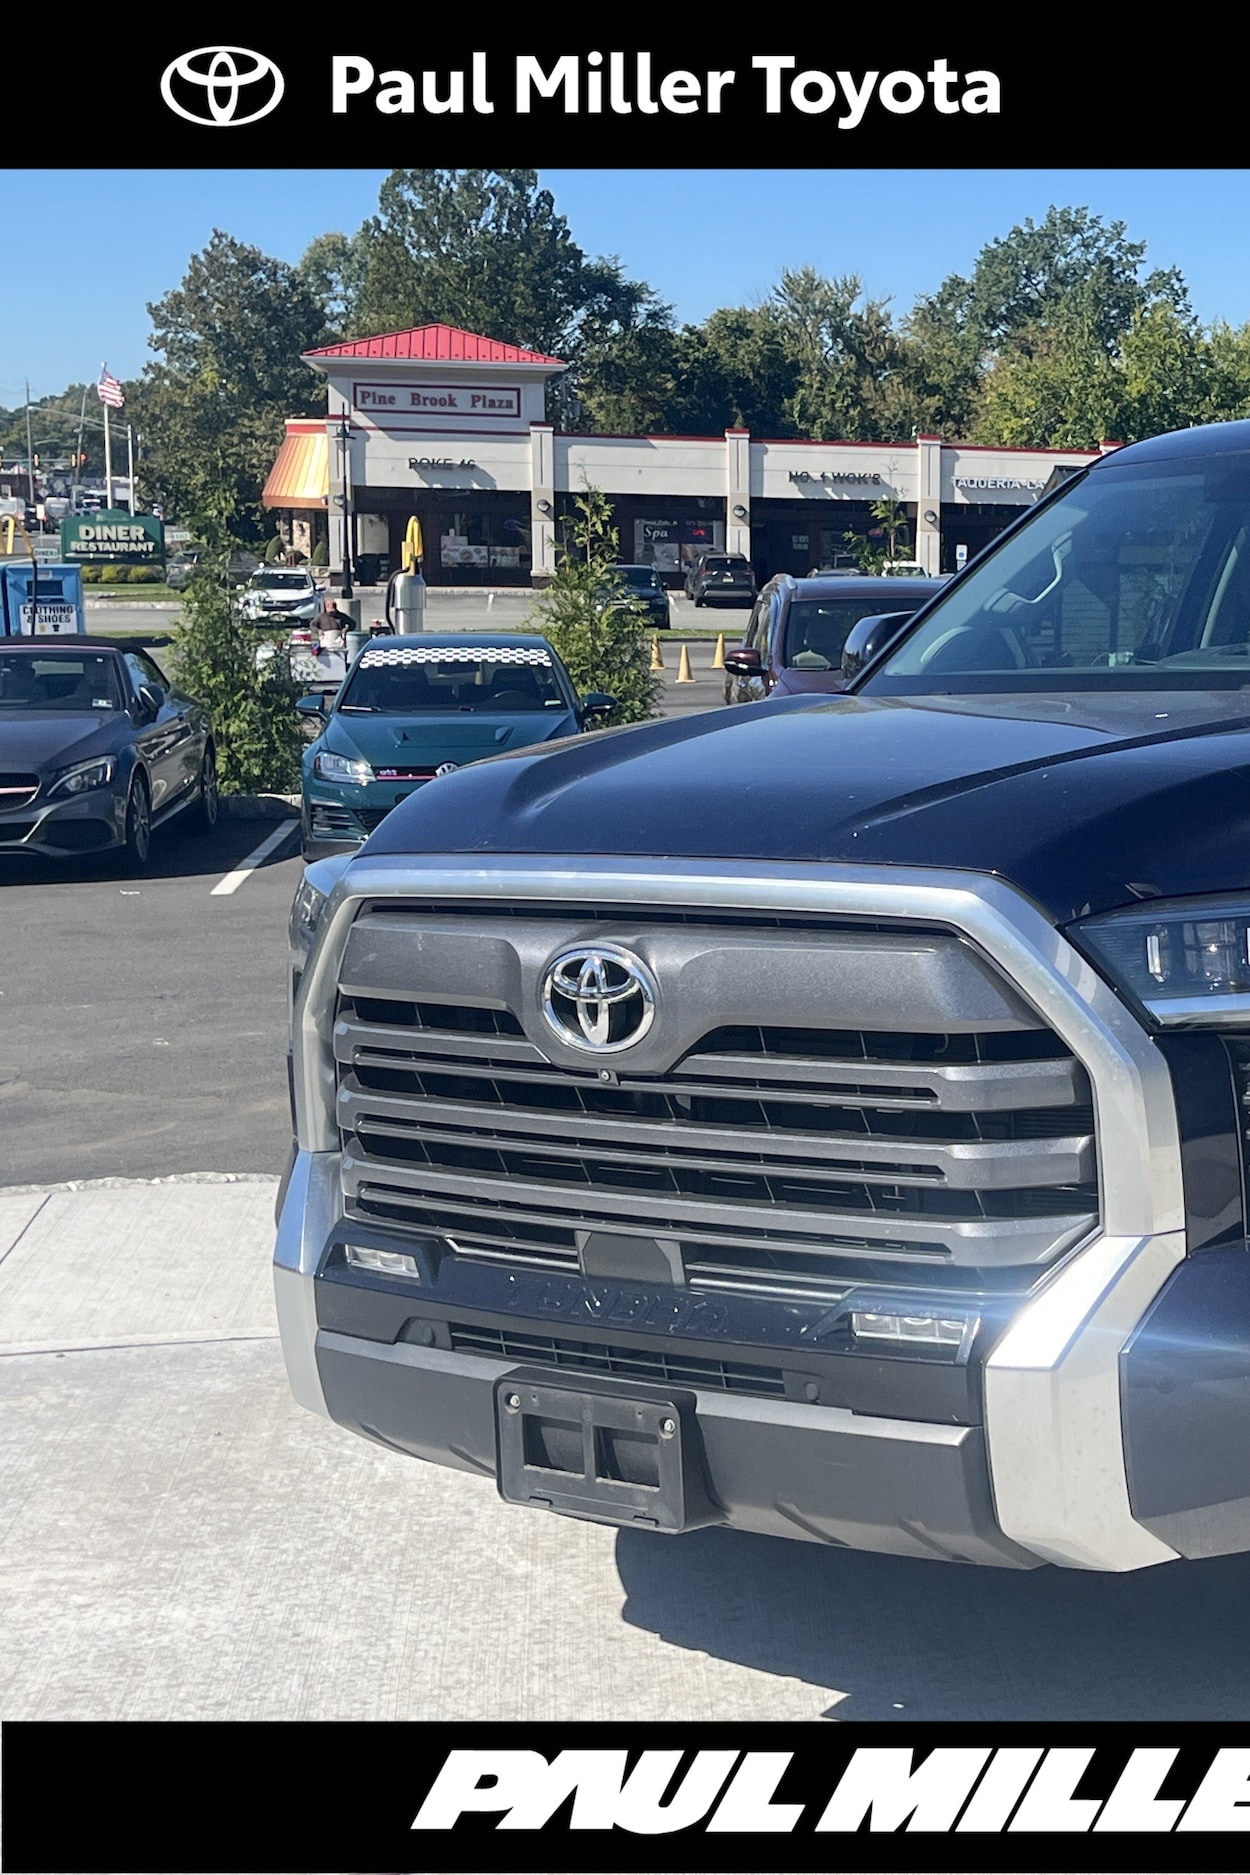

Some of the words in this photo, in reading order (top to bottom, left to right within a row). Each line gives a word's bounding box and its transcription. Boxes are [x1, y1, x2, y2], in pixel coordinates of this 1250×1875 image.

[360, 391, 396, 405] Pine
[410, 392, 458, 407] Brook
[470, 394, 514, 409] Plaza
[408, 457, 453, 470] POKE
[832, 472, 881, 485] WOK'S
[951, 476, 1021, 489] TAQUERIA
[79, 525, 145, 540] DINER
[644, 526, 669, 540] Spa
[70, 541, 155, 552] RESTAURANT
[38, 615, 71, 623] SHOES
